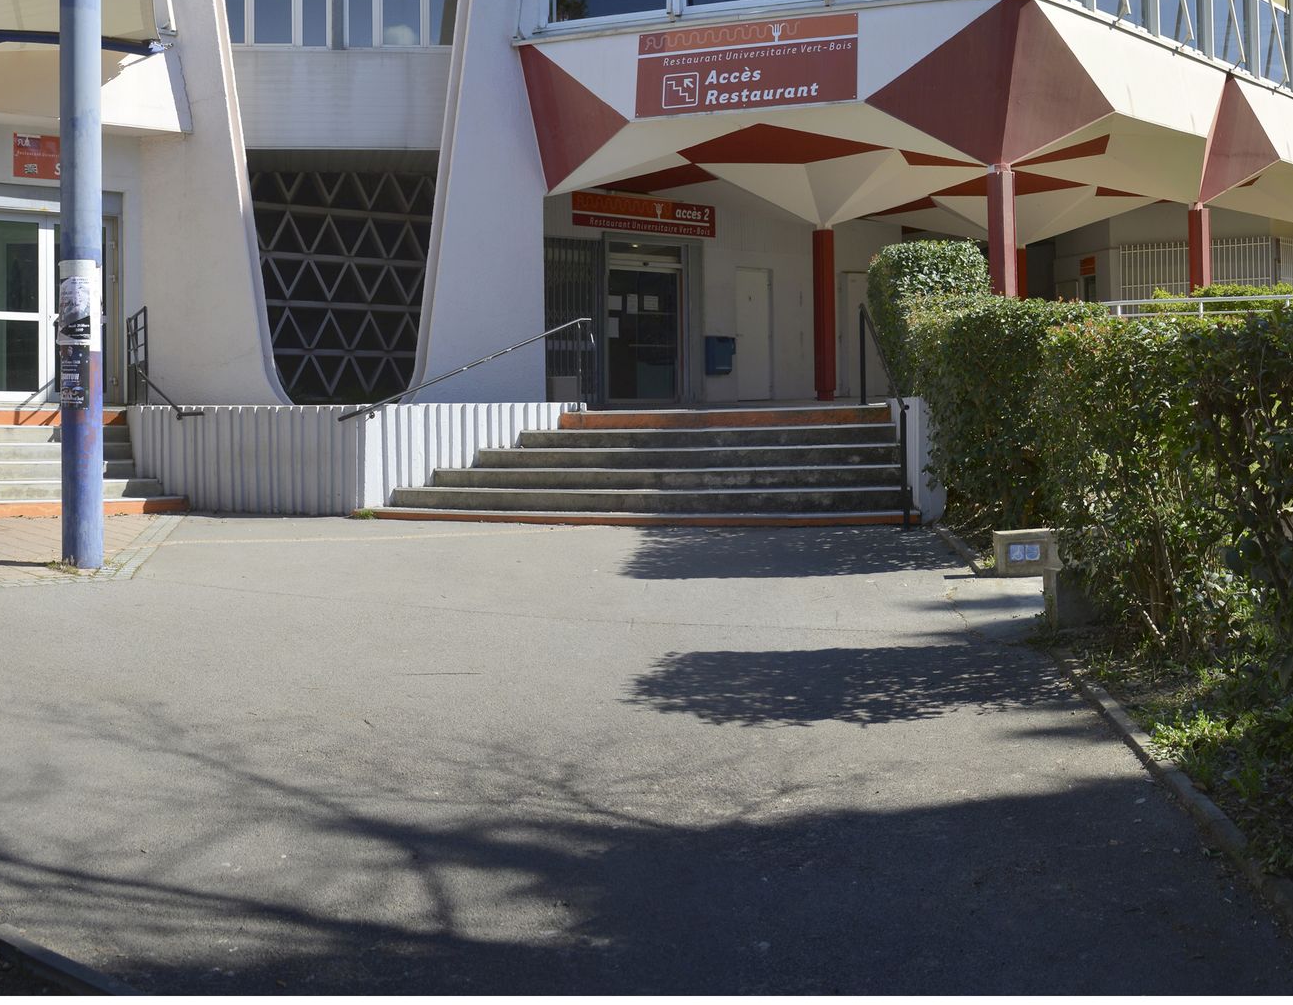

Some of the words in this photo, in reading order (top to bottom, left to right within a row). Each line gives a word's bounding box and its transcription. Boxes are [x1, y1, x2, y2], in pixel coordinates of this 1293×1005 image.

[662, 52, 722, 67] Restaurant
[725, 46, 797, 61] Universitaire
[800, 40, 852, 53] Vert-Bois
[705, 66, 761, 85] Accès
[705, 82, 819, 106] Restaurant
[675, 206, 702, 221] accès
[703, 208, 710, 221] 2
[589, 216, 631, 229] Restaurant
[631, 219, 678, 233] Universitaire
[679, 225, 711, 236] Vert-Bois
